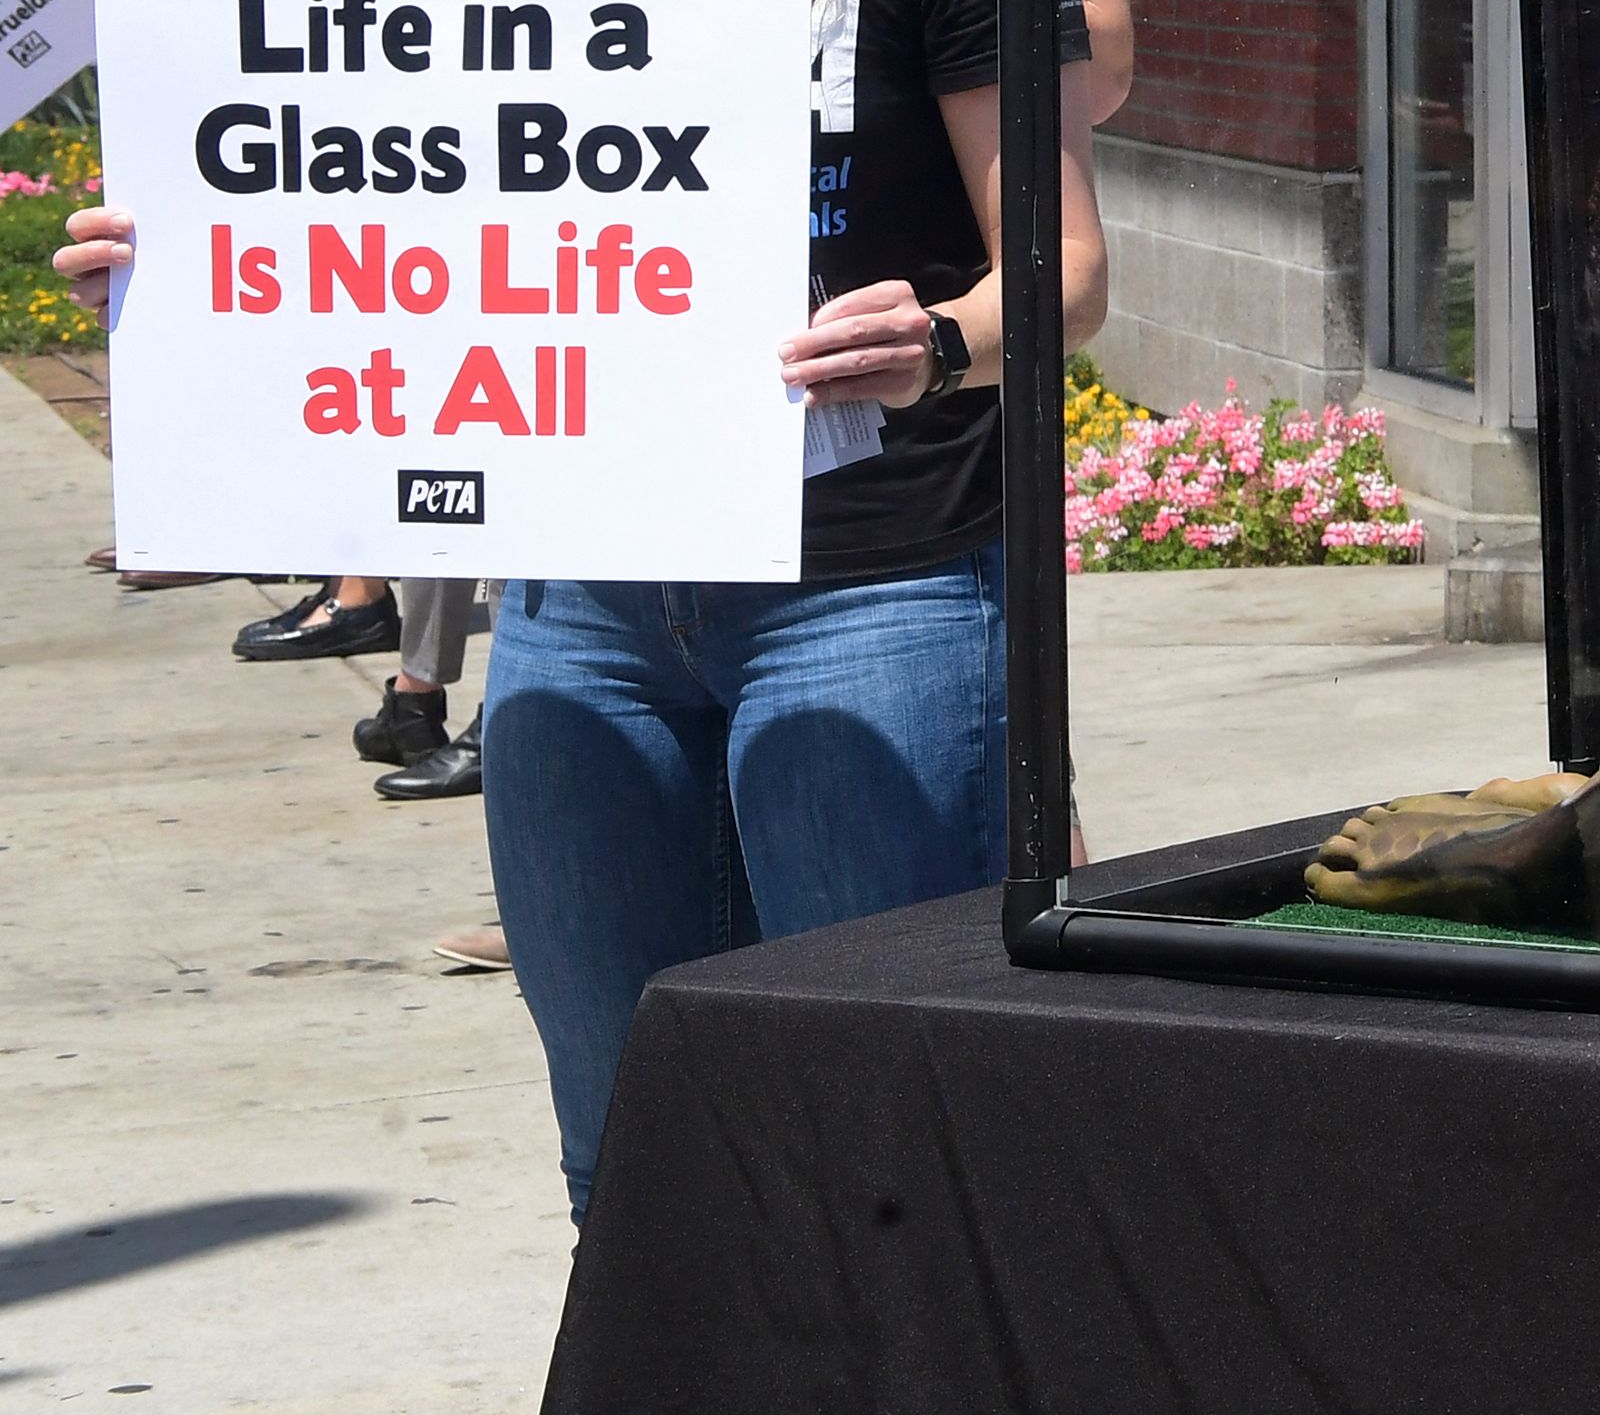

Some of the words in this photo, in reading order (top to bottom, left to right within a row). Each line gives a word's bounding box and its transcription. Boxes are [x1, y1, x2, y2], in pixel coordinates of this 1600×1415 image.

[586, 2, 653, 72] a
[195, 103, 467, 194] Glass
[498, 102, 711, 192] Box
[211, 224, 282, 314] Is
[308, 224, 450, 314] No
[480, 220, 693, 315] Life
[303, 347, 406, 436] at
[433, 346, 586, 436] All
